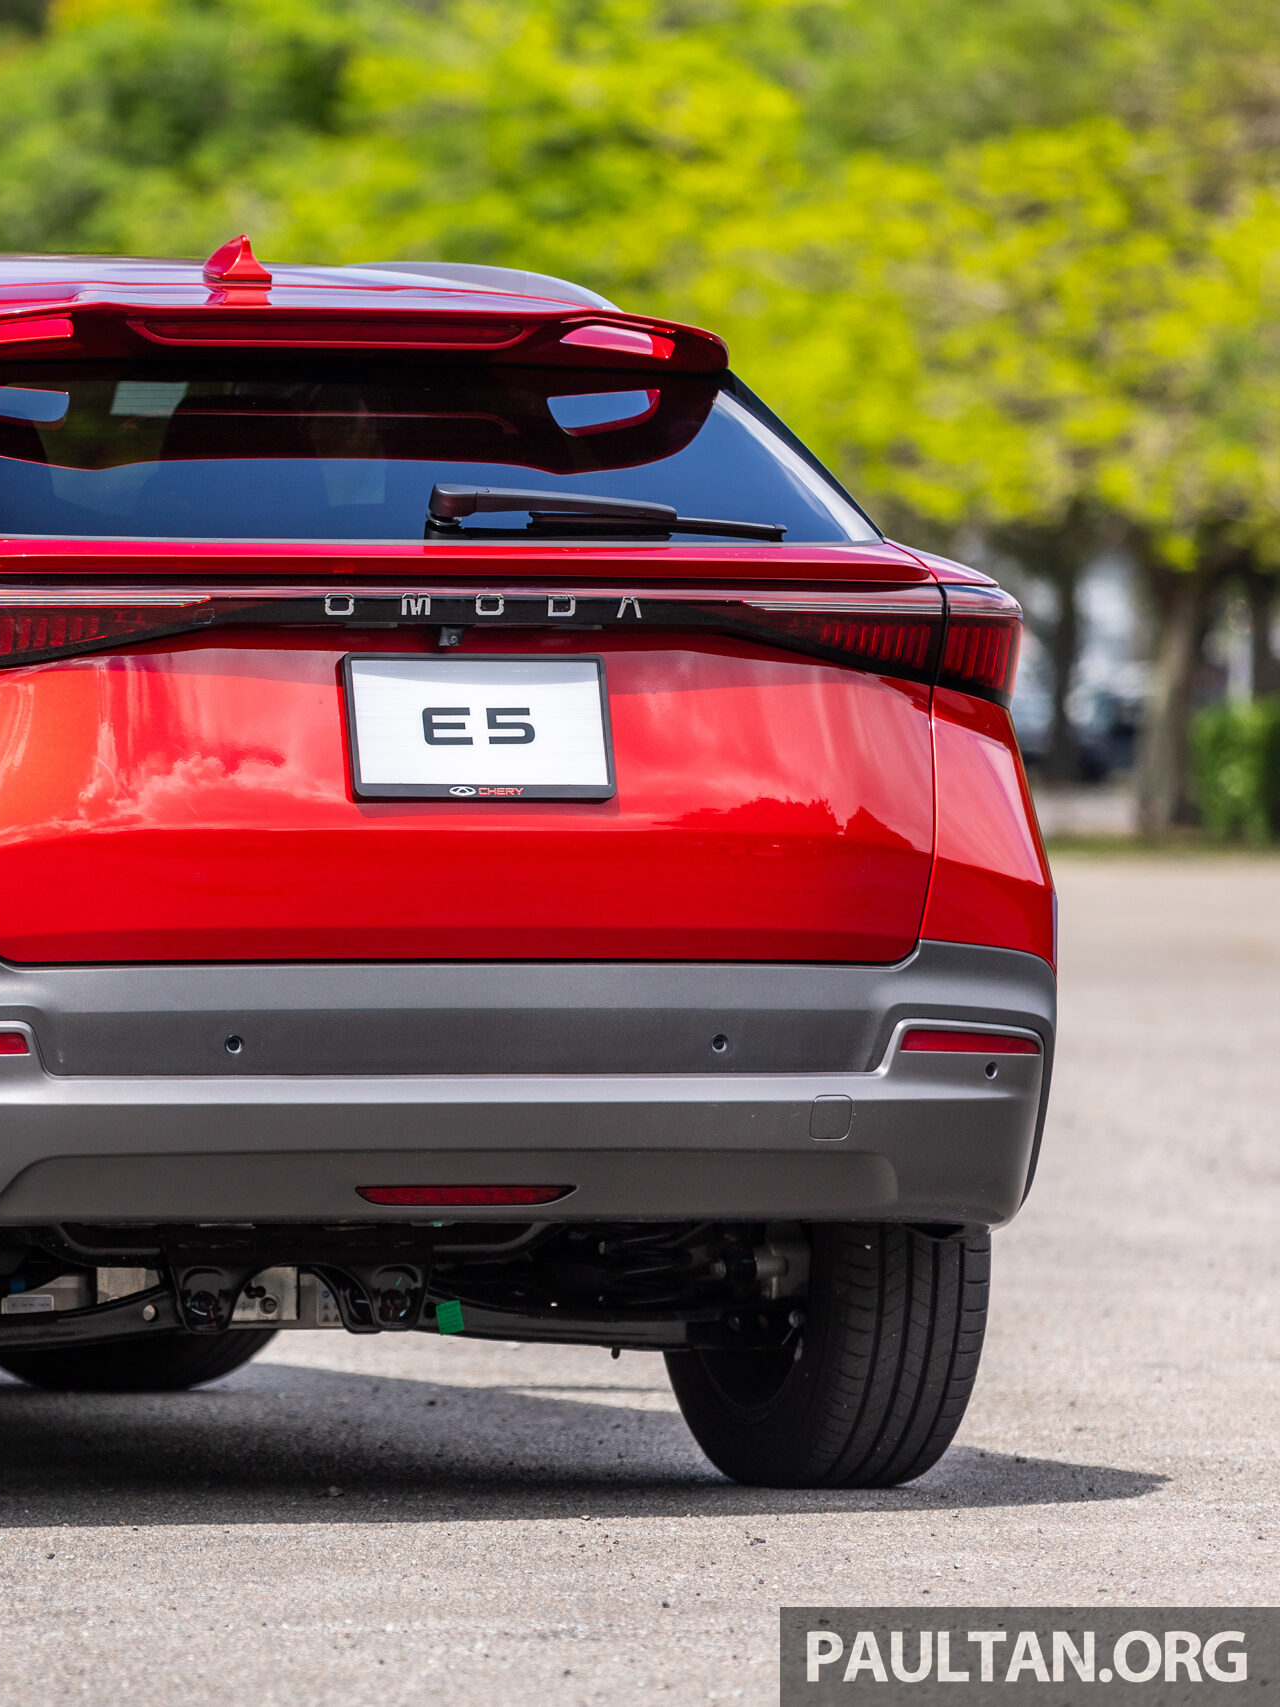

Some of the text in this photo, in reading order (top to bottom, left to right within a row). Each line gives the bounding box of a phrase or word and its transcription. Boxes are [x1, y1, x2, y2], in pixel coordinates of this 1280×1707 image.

[324, 593, 643, 619] OMODA
[421, 707, 536, 746] E5
[478, 787, 524, 796] CHERY
